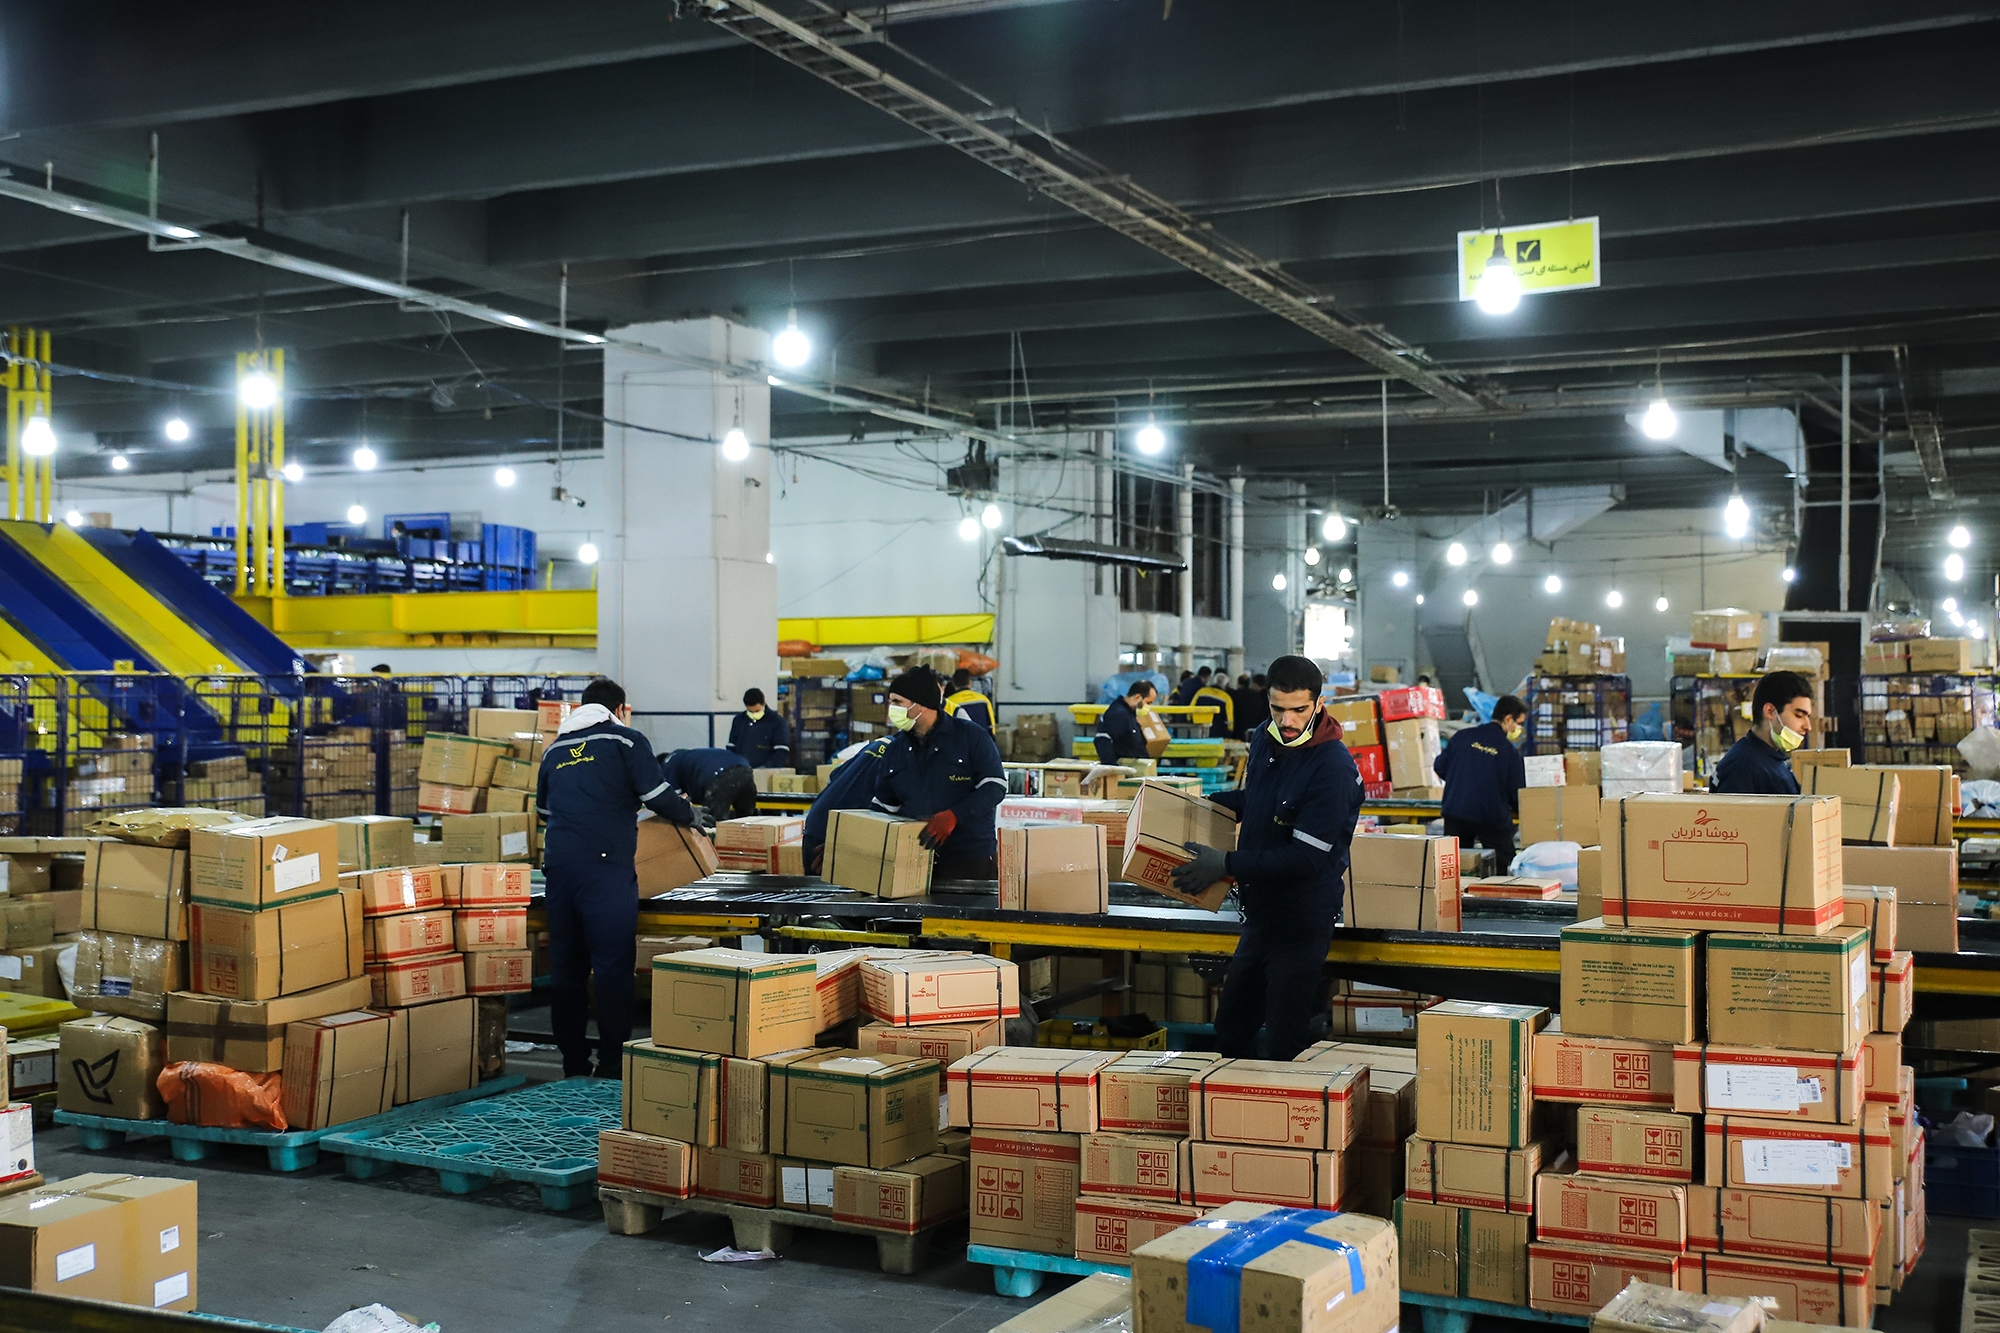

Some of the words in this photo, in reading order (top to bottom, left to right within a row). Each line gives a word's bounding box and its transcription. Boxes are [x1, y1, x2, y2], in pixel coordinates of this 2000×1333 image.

[1570, 260, 1590, 273] ایمنی
[1671, 827, 1703, 839] داریان
[1706, 827, 1739, 840] نیوشا
[1671, 910, 1742, 918] www.nedex.ir
[1735, 1055, 1788, 1064] www.nedex.ir
[1768, 1130, 1822, 1139] www.nedex.ir
[995, 1143, 1054, 1154] www.nedex.ir
[1609, 1166, 1660, 1174] www.nedex.ir
[1443, 1197, 1491, 1206] www.nedex.ir
[1750, 1246, 1804, 1257] www.nedex.ir
[1741, 1265, 1796, 1276] www.nedex.ir
